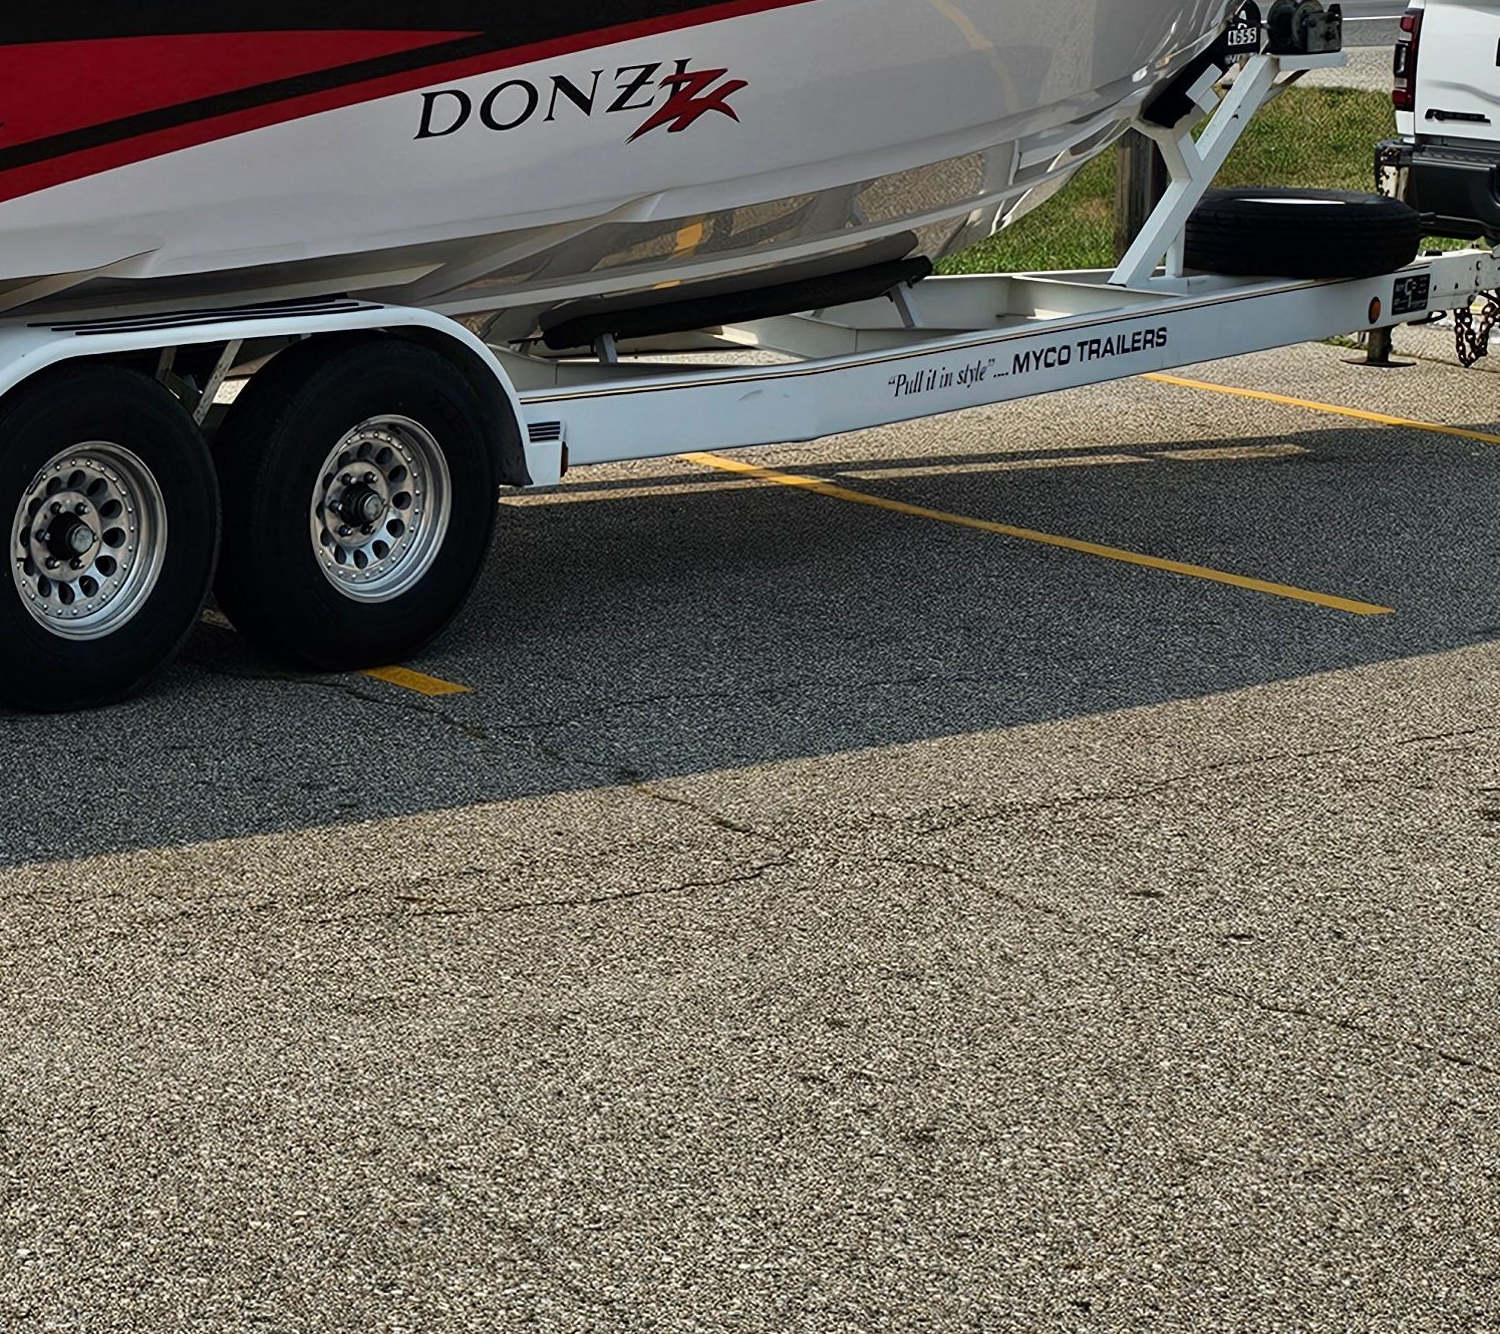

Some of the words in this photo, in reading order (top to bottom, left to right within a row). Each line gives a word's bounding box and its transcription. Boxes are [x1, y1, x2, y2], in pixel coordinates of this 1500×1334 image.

[413, 58, 692, 139] DONZI
[926, 368, 937, 391] it
[940, 367, 952, 388] in
[1012, 345, 1071, 375] MYCO
[1077, 327, 1167, 363] TRAILERS
